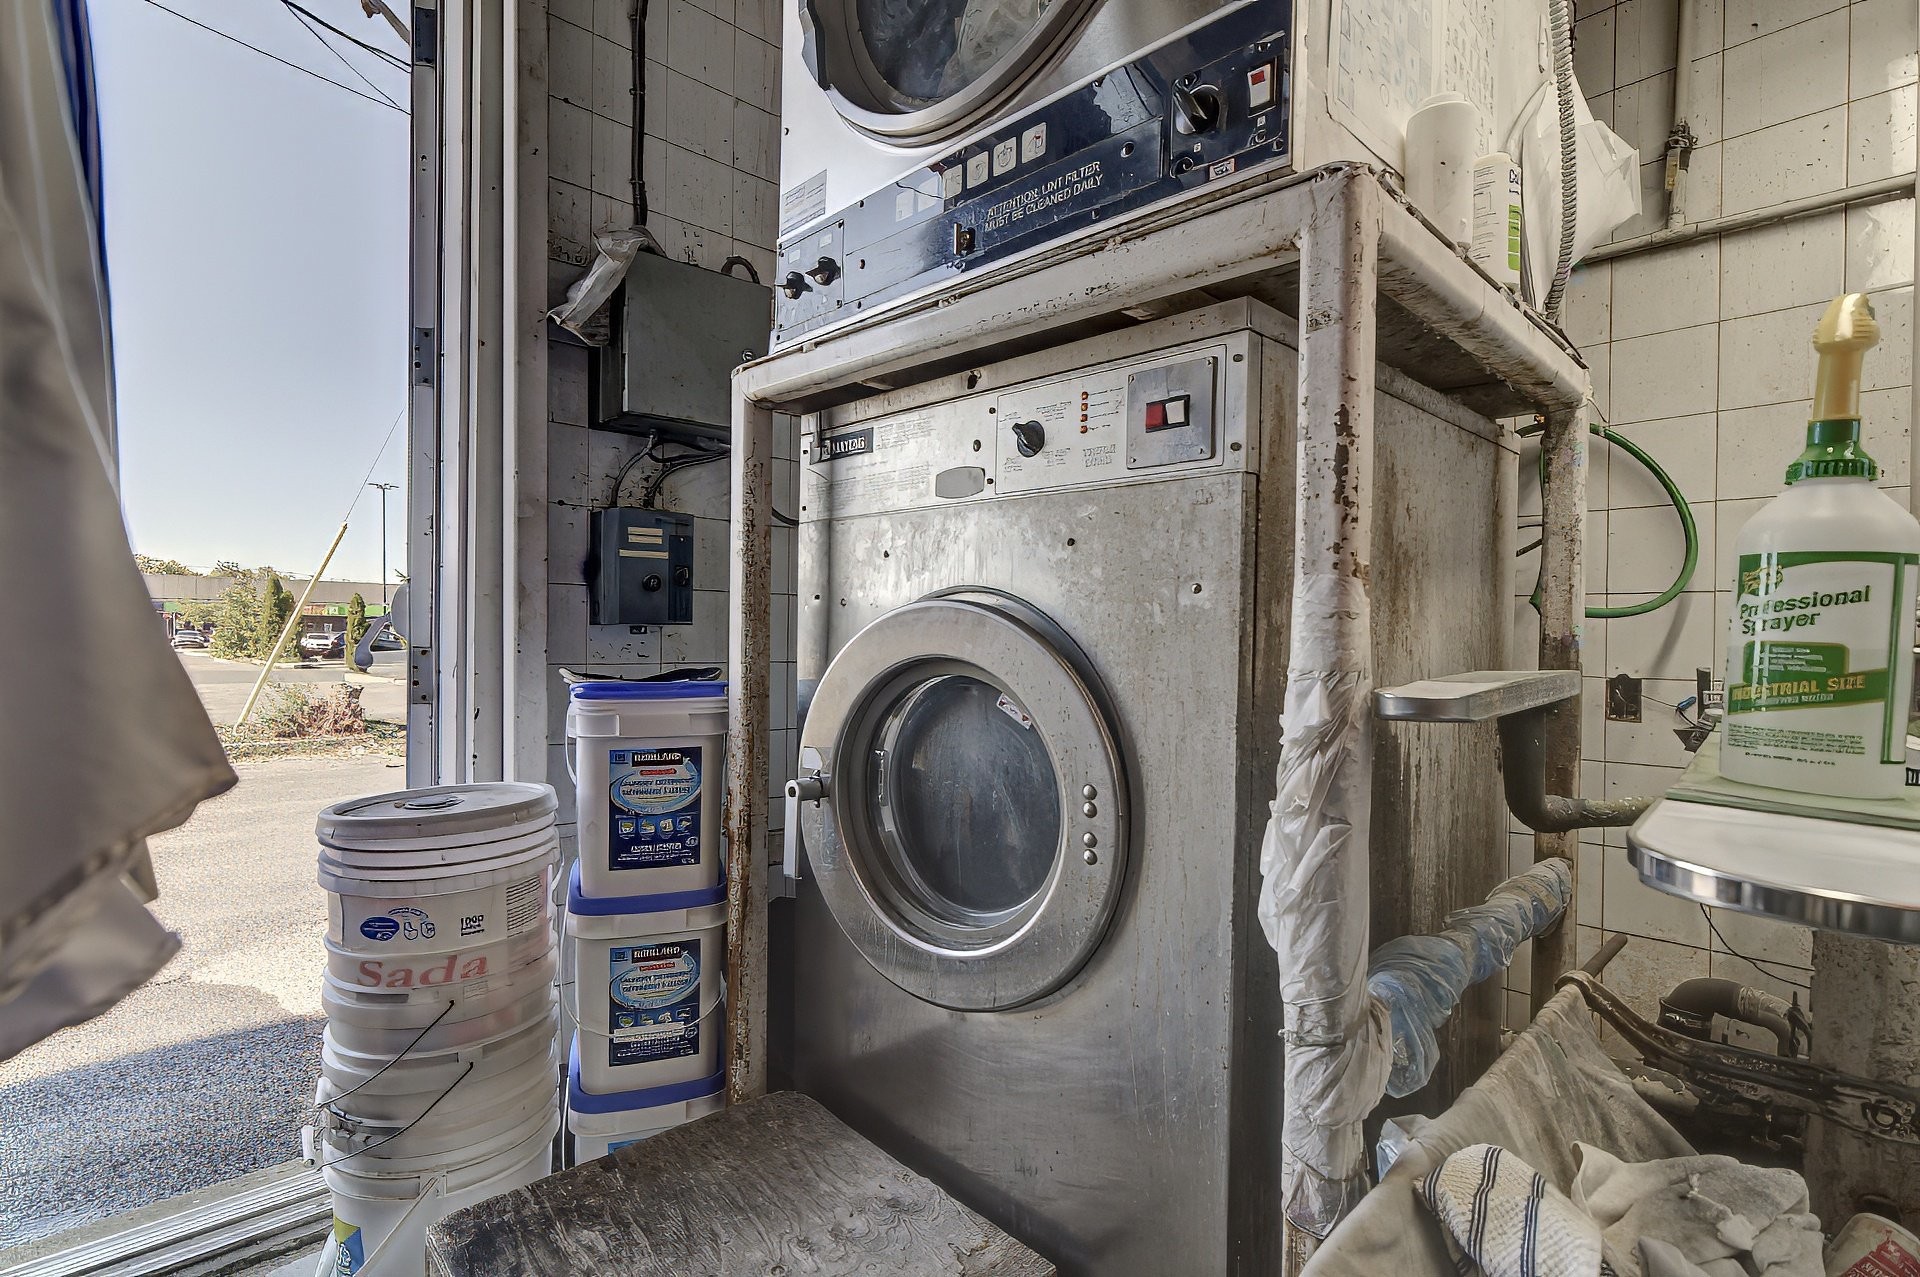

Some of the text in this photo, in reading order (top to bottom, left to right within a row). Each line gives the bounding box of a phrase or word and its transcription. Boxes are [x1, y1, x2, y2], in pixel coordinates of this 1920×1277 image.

[1066, 161, 1100, 183] FILTER
[1026, 188, 1071, 214] CLEANED
[1073, 174, 1103, 195] DAILY
[358, 954, 488, 988] Sada
